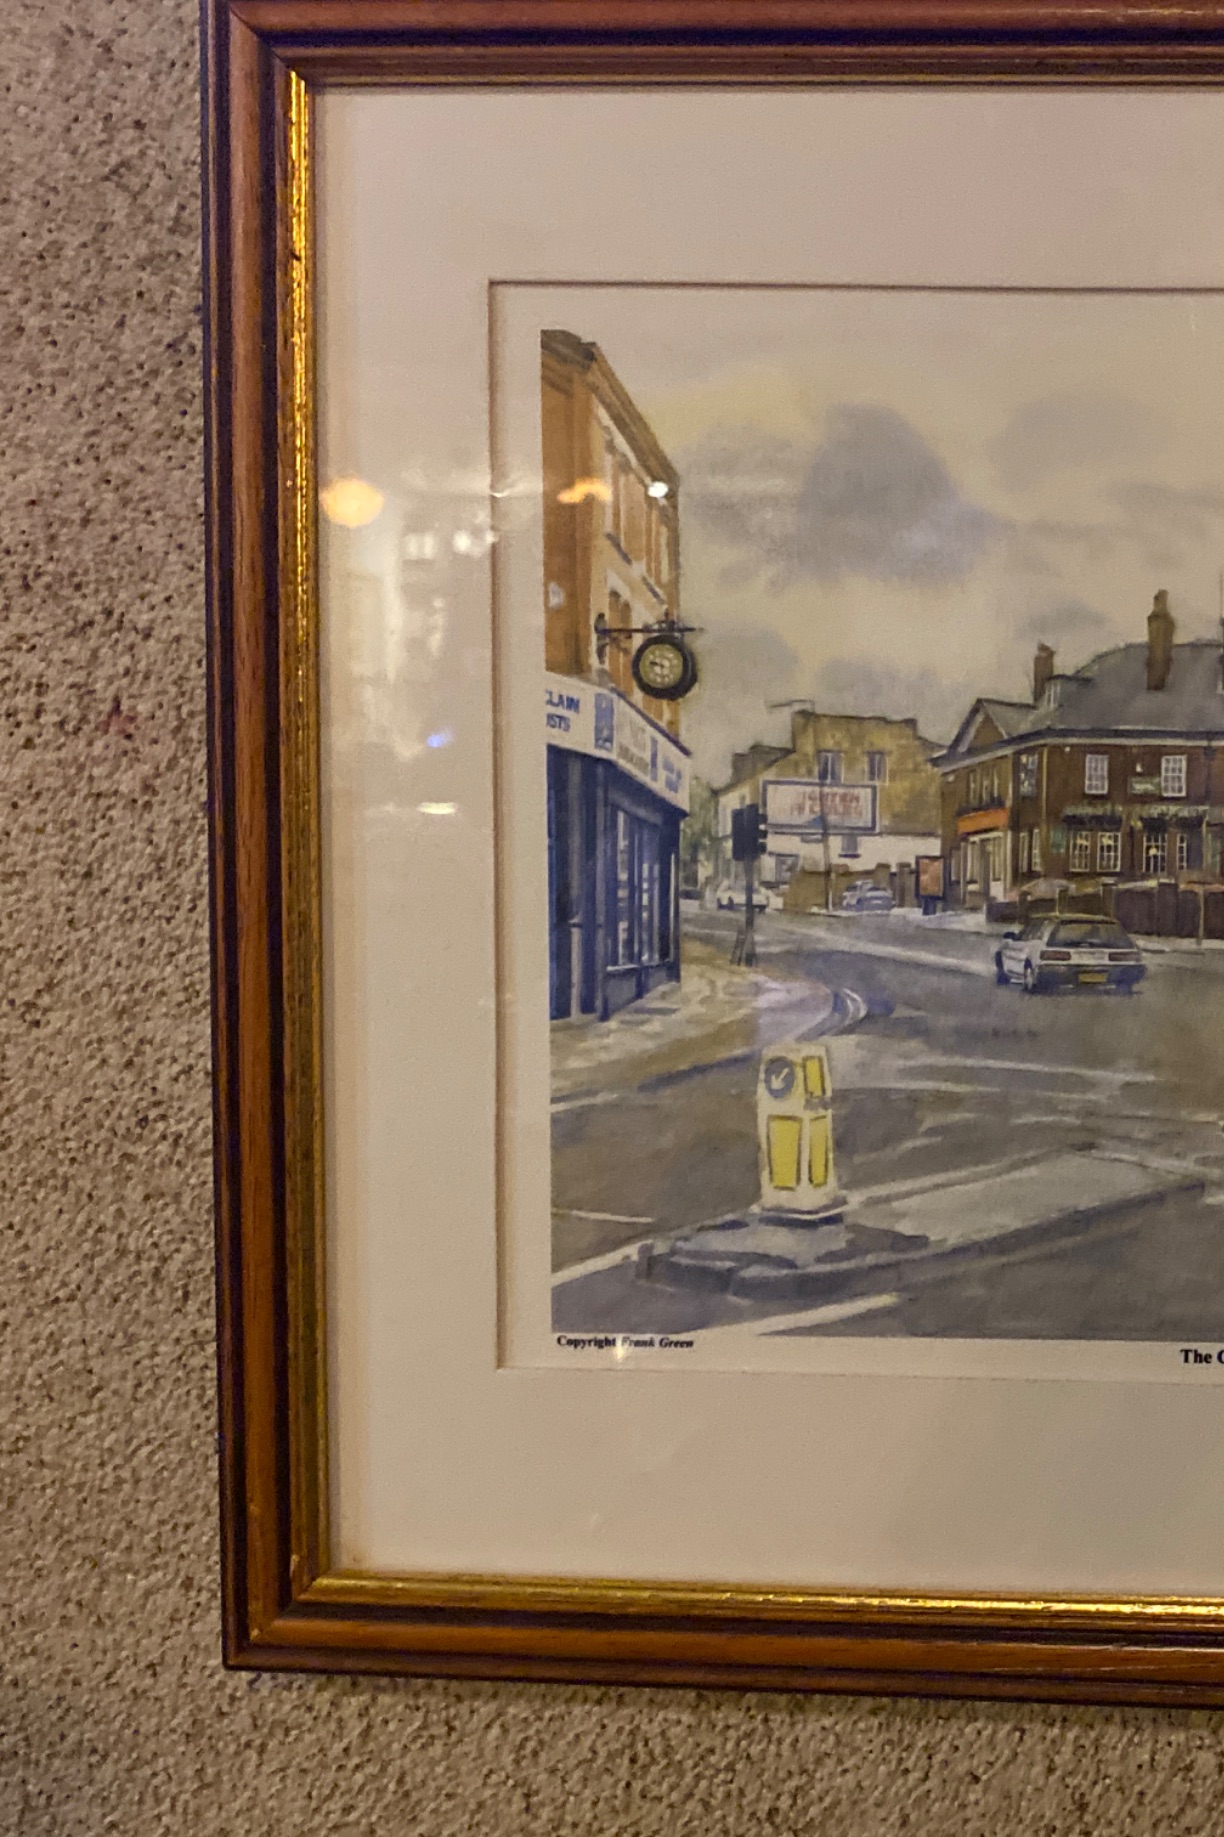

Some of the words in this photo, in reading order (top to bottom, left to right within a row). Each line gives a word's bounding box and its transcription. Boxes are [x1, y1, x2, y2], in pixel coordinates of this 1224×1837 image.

[557, 1335, 616, 1349] Copyright
[621, 1336, 655, 1348] Frank
[659, 1337, 694, 1349] Green
[1180, 1349, 1212, 1365] The
